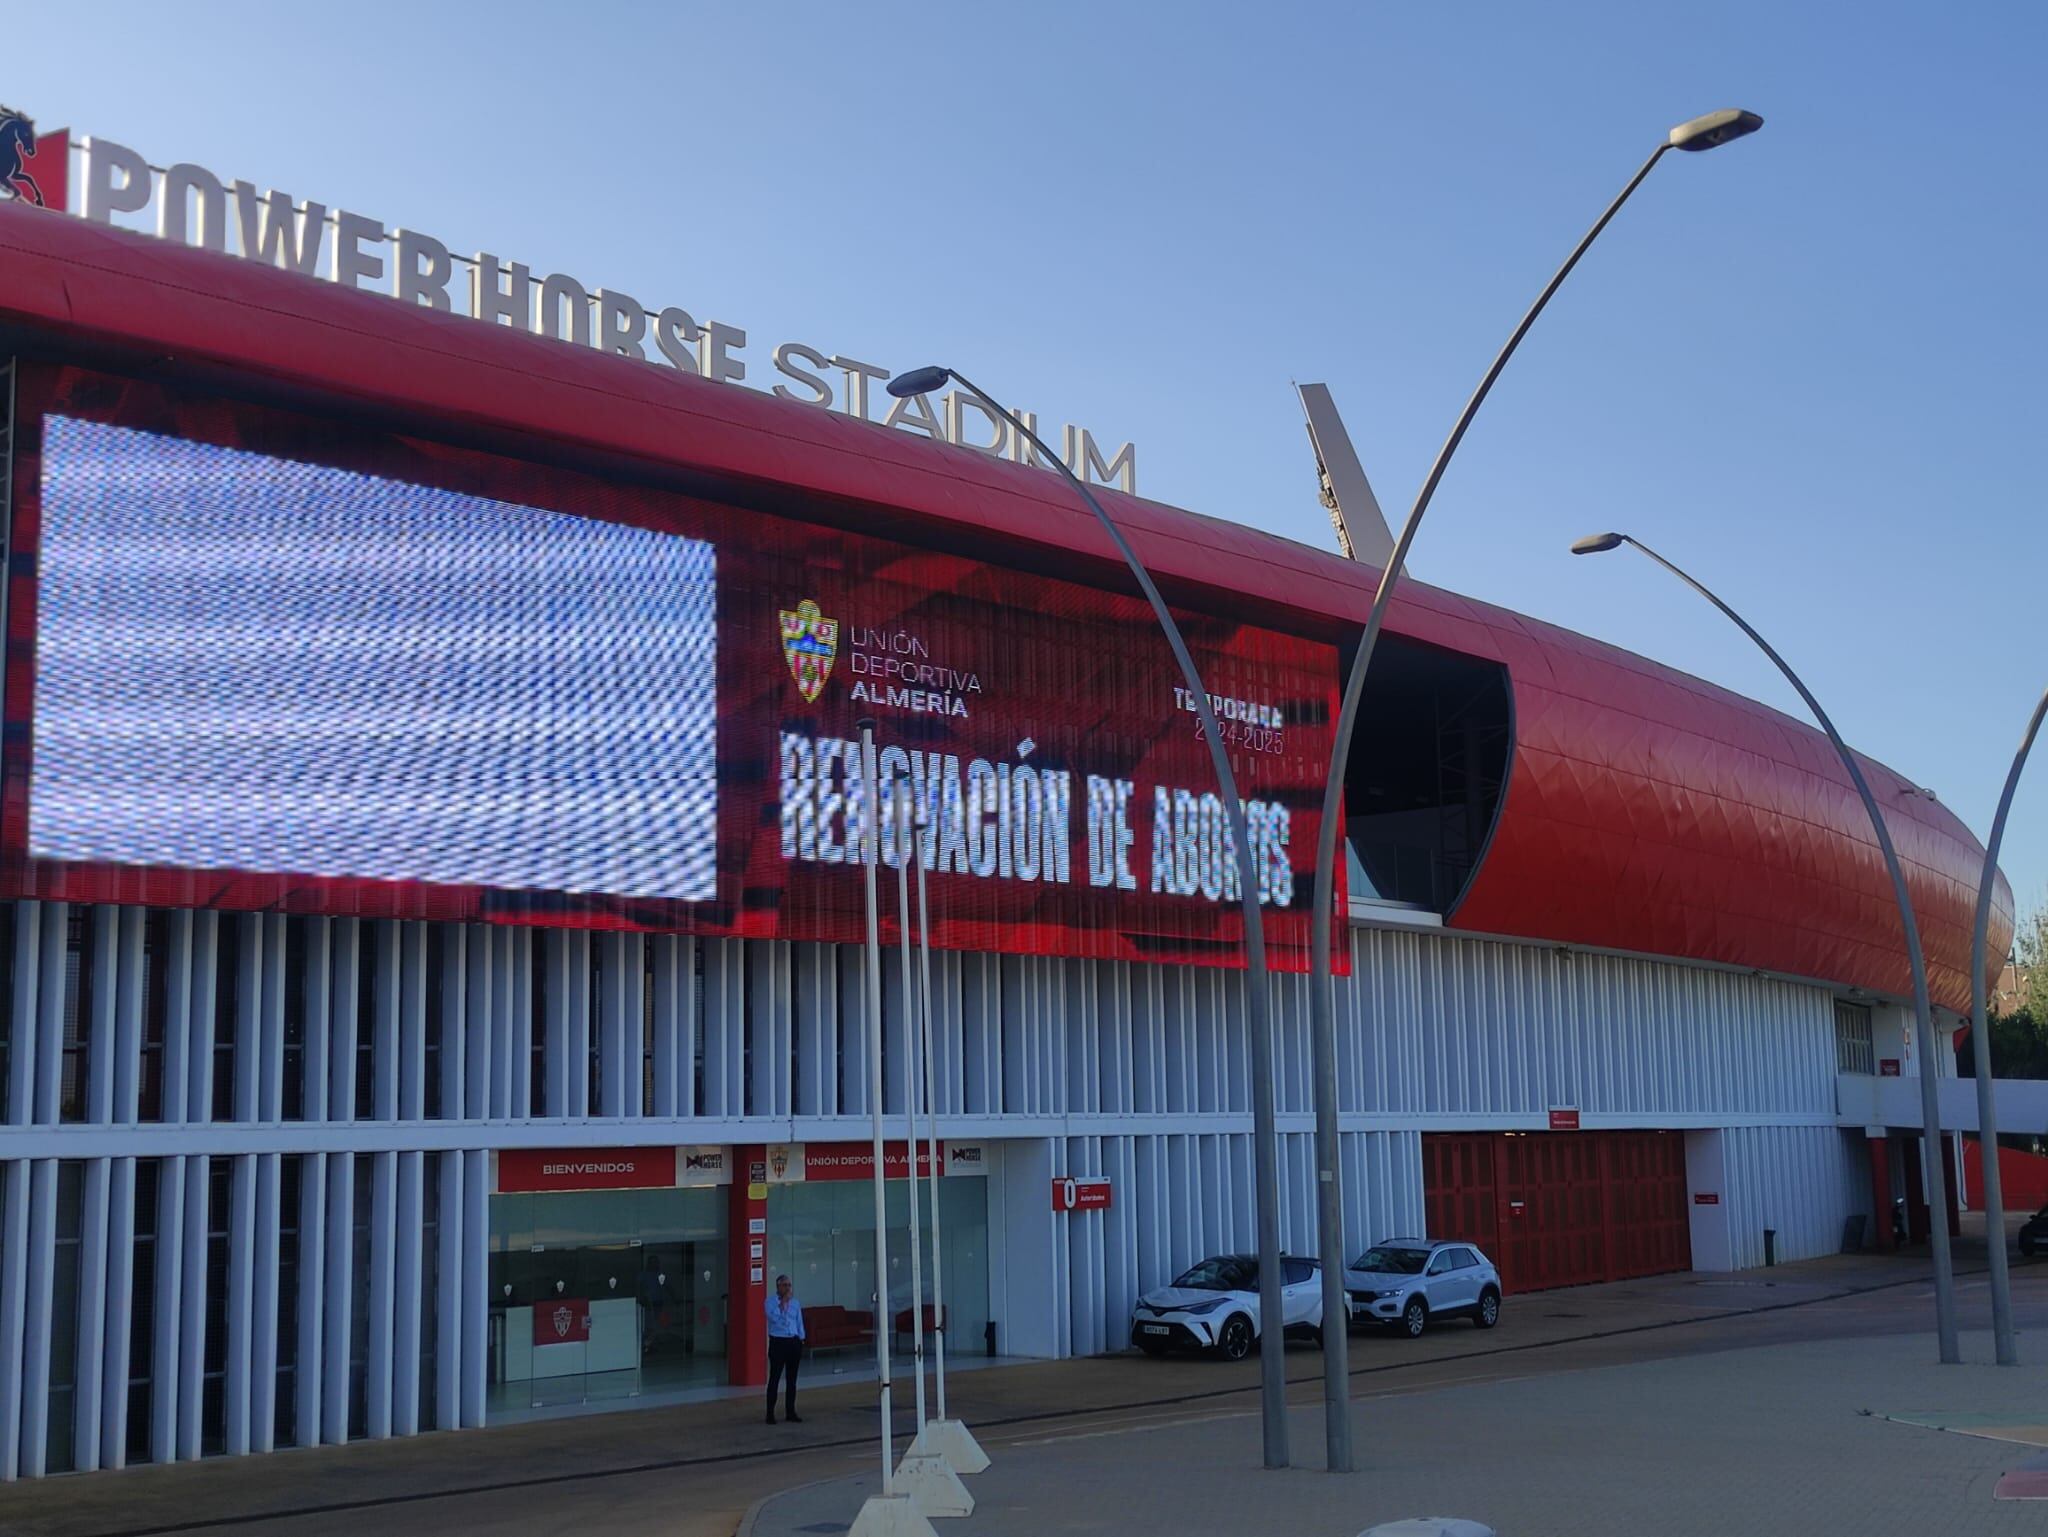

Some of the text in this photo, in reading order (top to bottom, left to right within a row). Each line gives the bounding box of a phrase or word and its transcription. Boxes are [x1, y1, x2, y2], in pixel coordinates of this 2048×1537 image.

[81, 136, 1136, 496] POWER HORSE STADIUM
[851, 624, 929, 659] UNIÓN
[851, 652, 982, 694] DEPORTIVA
[850, 680, 969, 718] ALMERÍA
[1173, 687, 1283, 729] TEPORADA
[1194, 717, 1283, 755] 224-2025
[780, 730, 1070, 883] RENOVACIÓN
[1087, 774, 1136, 890] DE
[543, 1162, 635, 1175] BIENVENIDOS
[807, 1154, 839, 1166] UNIÓN
[841, 1154, 897, 1166] DEPORVA
[1064, 1179, 1076, 1208] 0
